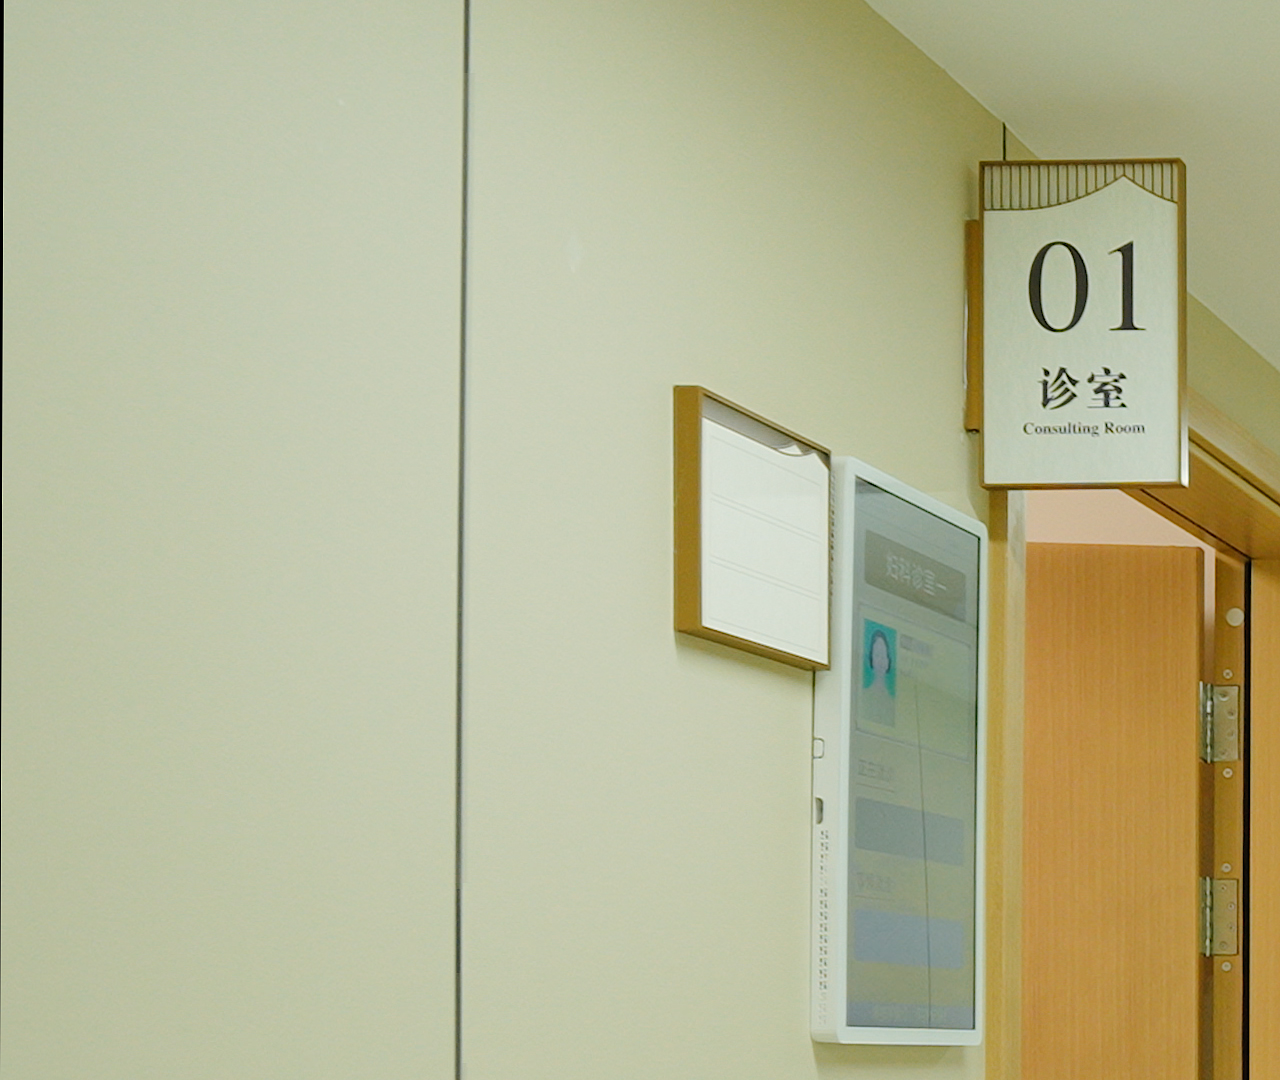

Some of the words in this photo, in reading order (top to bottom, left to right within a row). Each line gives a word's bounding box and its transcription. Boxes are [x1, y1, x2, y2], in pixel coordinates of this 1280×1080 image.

[1029, 240, 1145, 333] 01
[1038, 367, 1128, 410] 诊室
[1023, 422, 1100, 437] Consulting
[1104, 422, 1145, 435] Room
